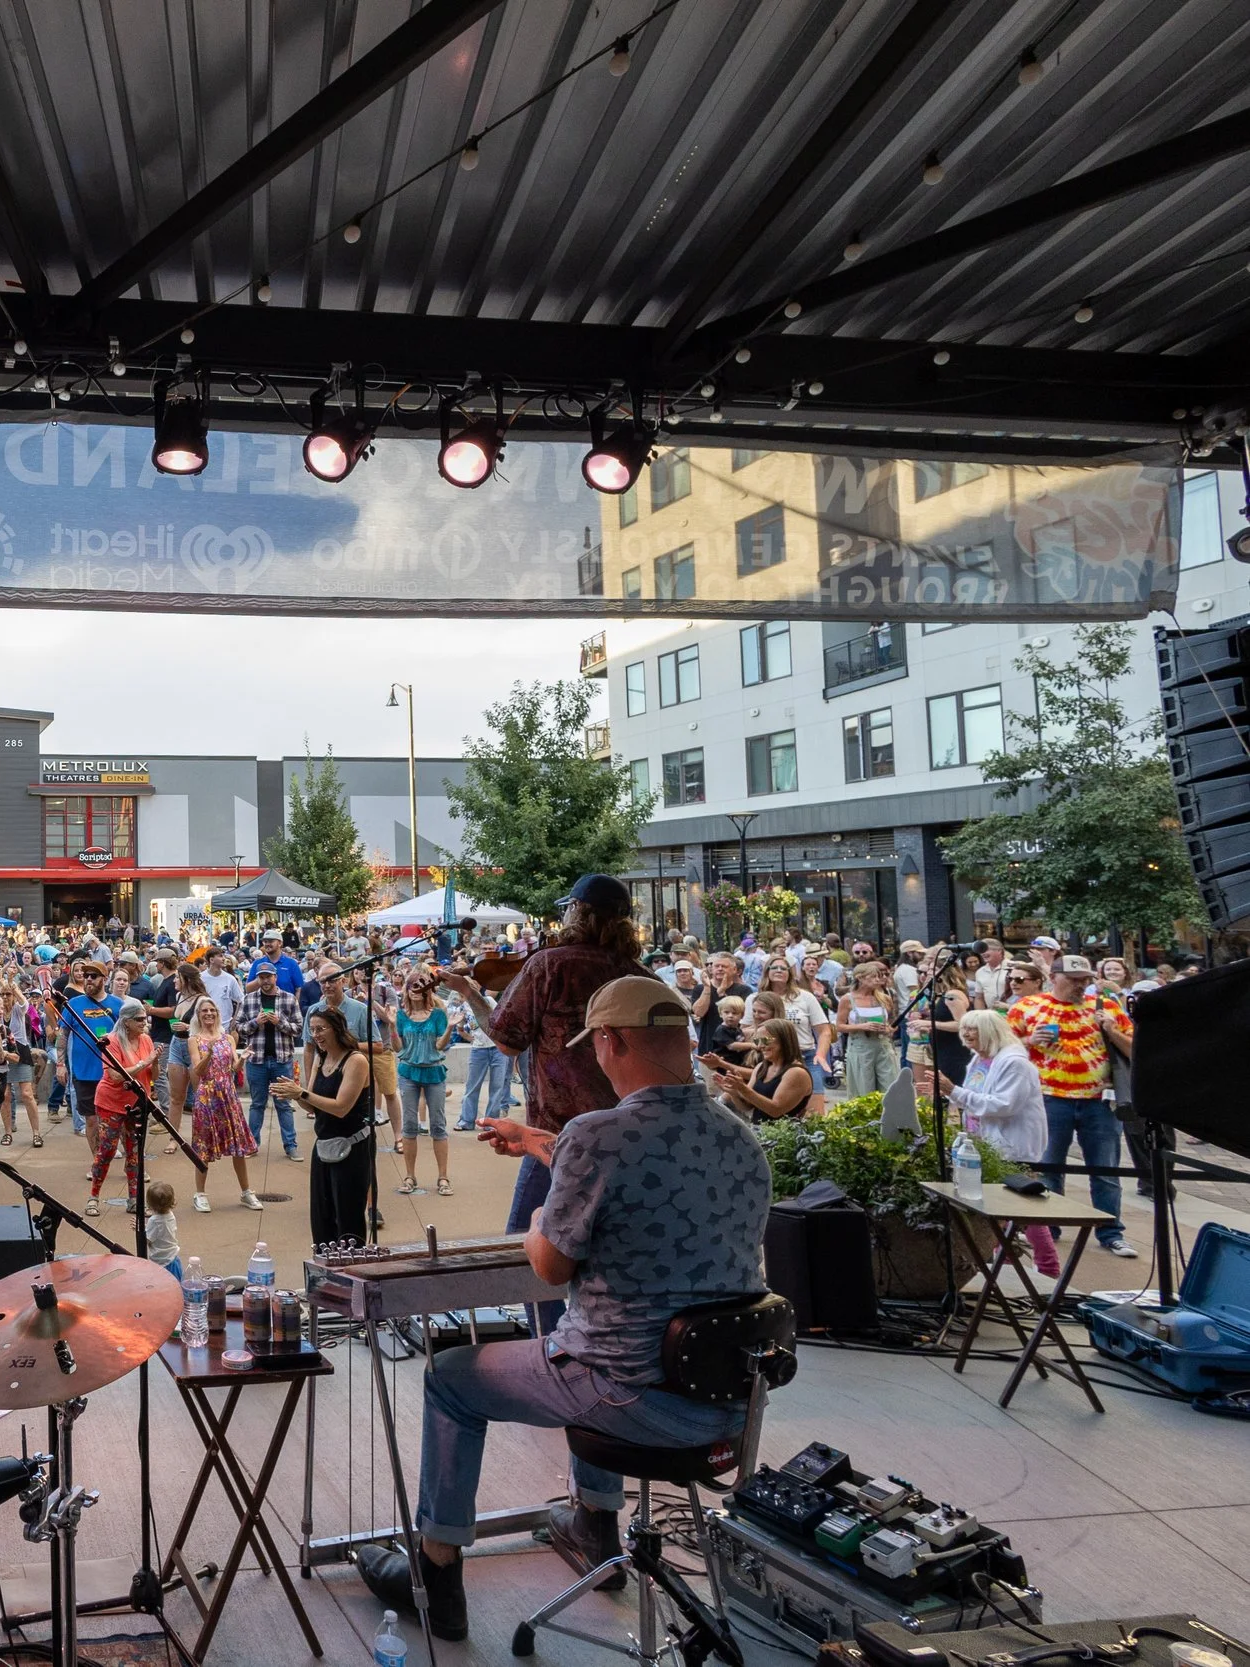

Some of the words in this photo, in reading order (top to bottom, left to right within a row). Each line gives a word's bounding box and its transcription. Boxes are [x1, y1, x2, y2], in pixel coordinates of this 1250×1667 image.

[4, 739, 23, 747] 285
[42, 760, 149, 772] METROLUX
[45, 774, 100, 782] THEATRES
[79, 852, 113, 863] Scripted
[9, 1359, 37, 1369] EFX
[707, 1450, 735, 1464] Gibraltar
